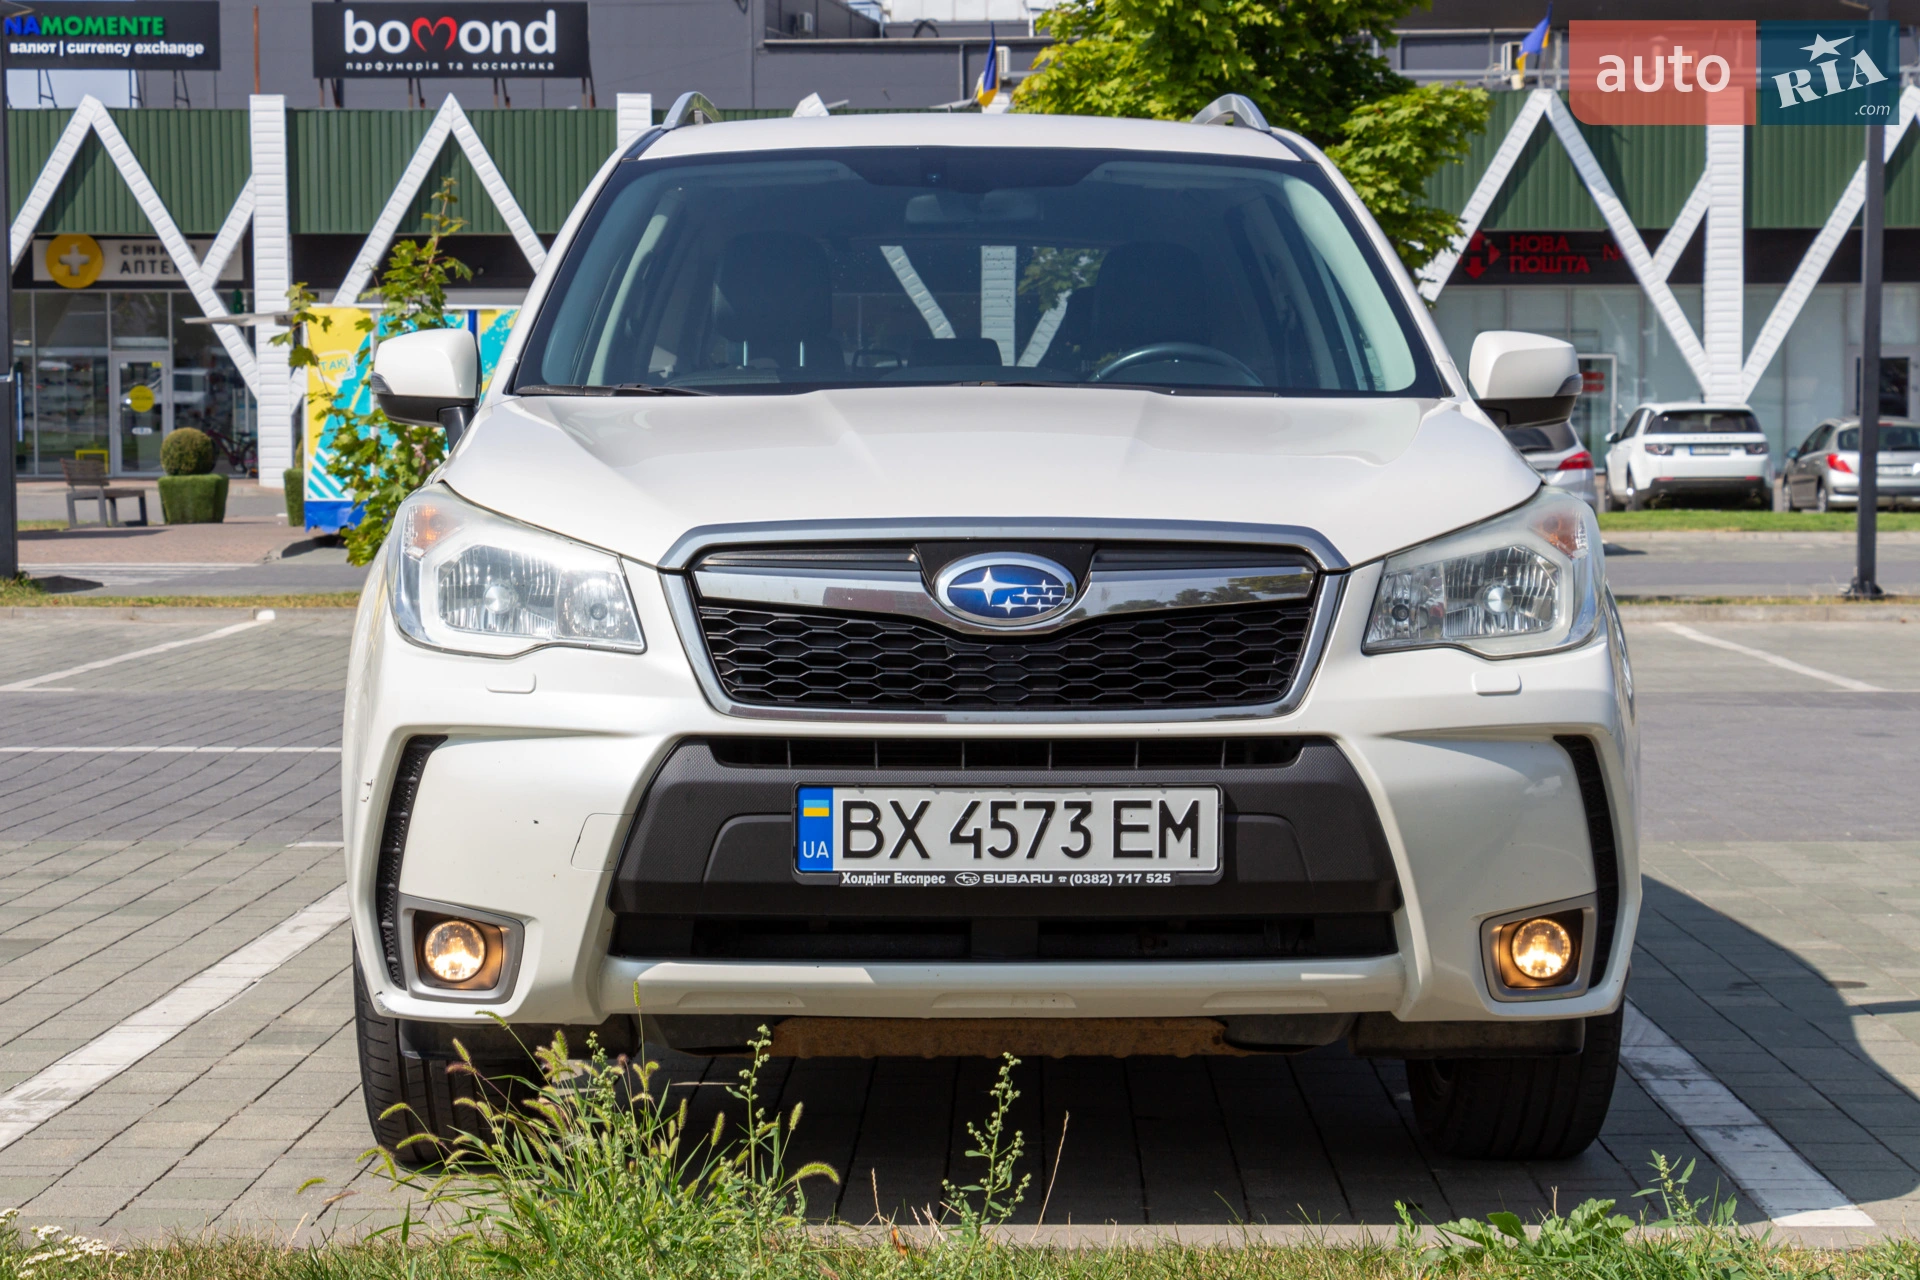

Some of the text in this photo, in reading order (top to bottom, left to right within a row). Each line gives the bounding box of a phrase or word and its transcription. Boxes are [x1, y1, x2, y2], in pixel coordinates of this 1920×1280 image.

[344, 9, 556, 54] bomond
[10, 41, 205, 57] валют currency exchange
[346, 61, 555, 71] парфумерія та косметика
[1509, 236, 1570, 252] НОВА
[1509, 256, 1591, 273] ПОШТА
[841, 800, 1199, 860] BX 4573 EM
[803, 840, 829, 859] UA
[841, 872, 1171, 886] Холдінг Експрес SUBARU (0382) 717 525
